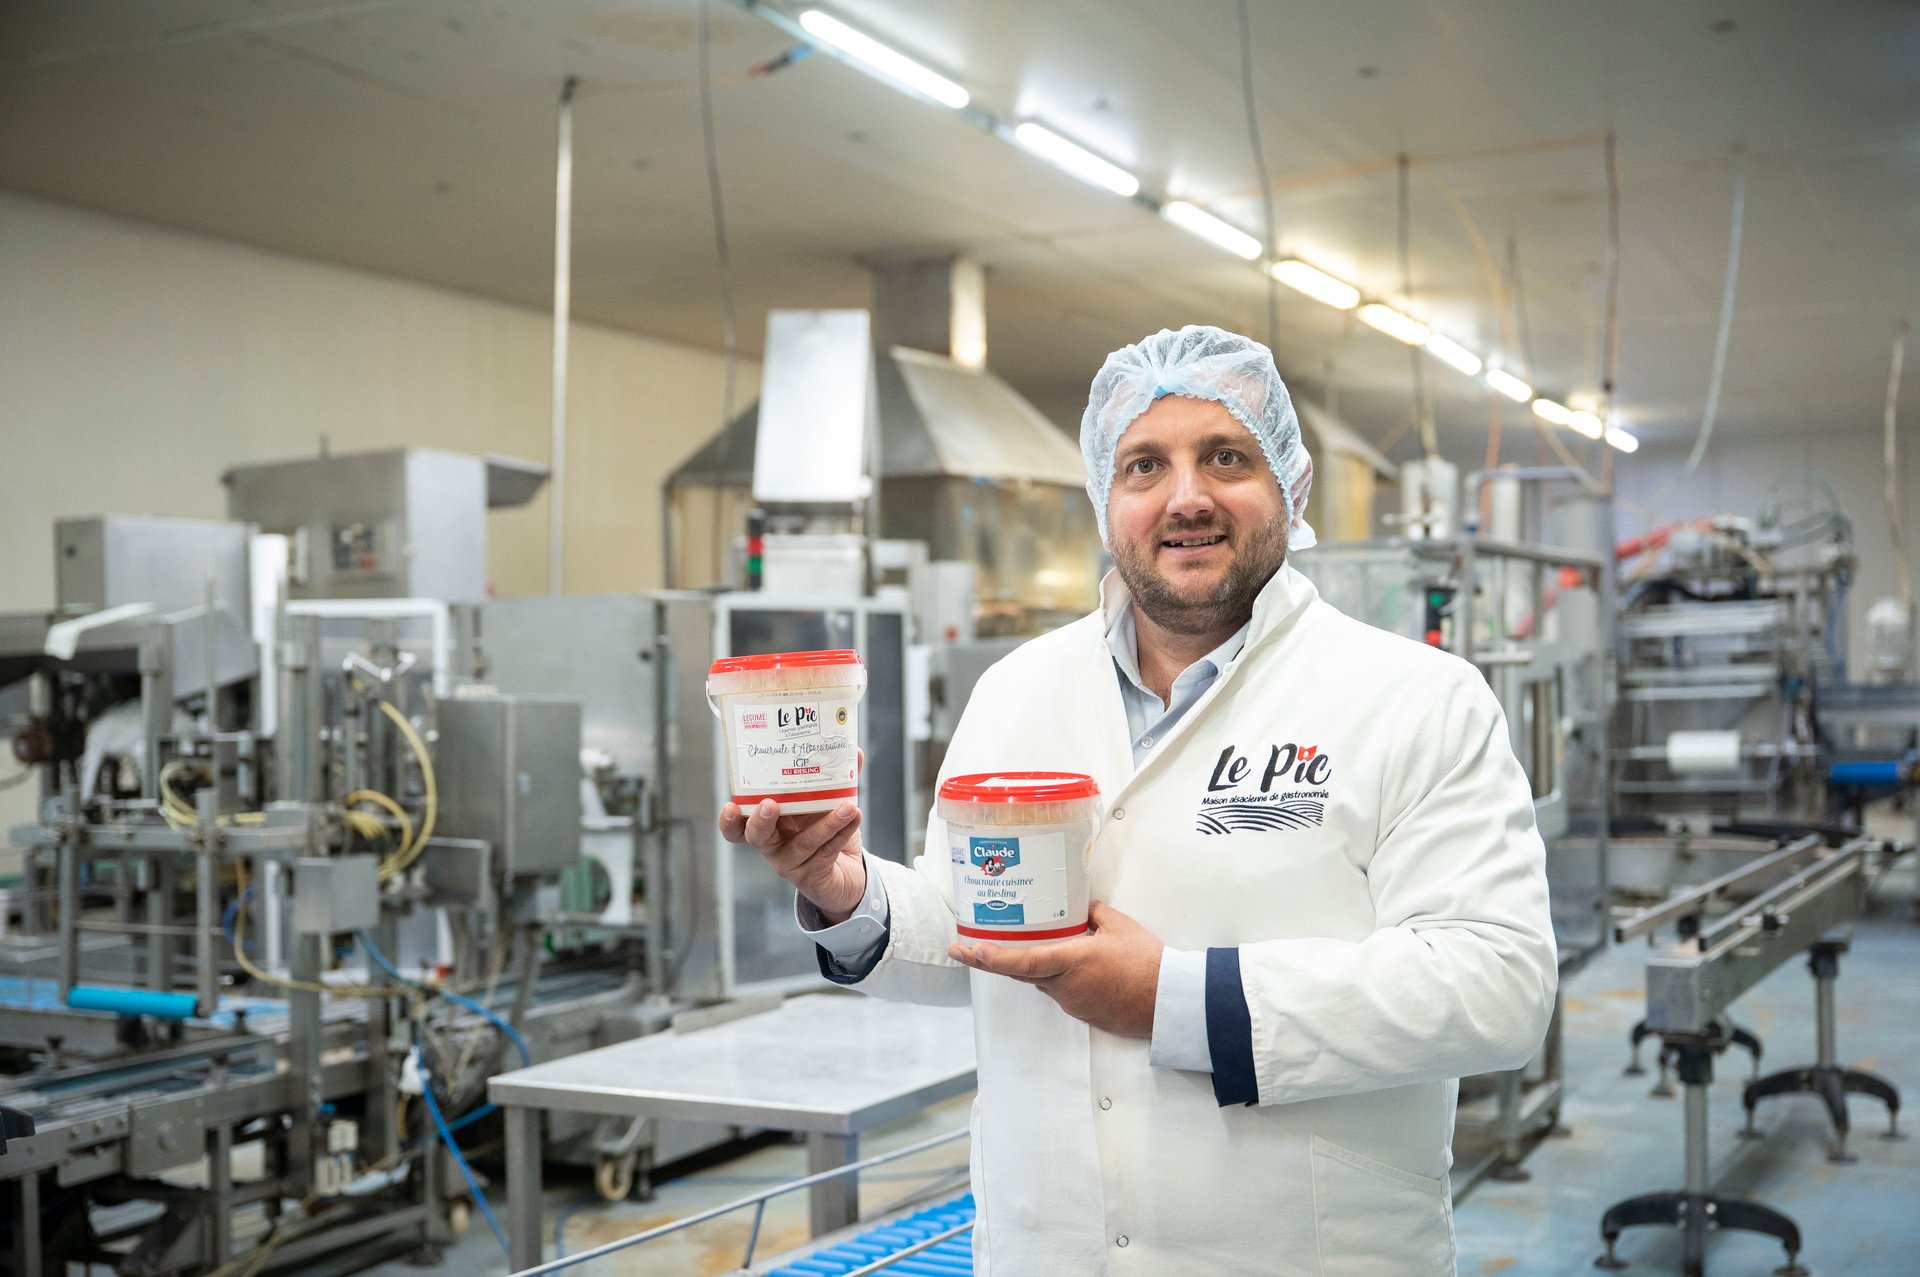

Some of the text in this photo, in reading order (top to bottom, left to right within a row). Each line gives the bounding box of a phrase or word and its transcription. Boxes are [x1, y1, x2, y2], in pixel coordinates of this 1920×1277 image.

[778, 706, 817, 728] Le Pic
[793, 758, 809, 768] IGP
[1207, 742, 1332, 793] Le Pic
[1201, 789, 1330, 805] Maison alsacienne de gastronomie
[973, 846, 1016, 858] Claude
[964, 875, 1001, 886] Choucroute
[986, 889, 1017, 899] Riesling
